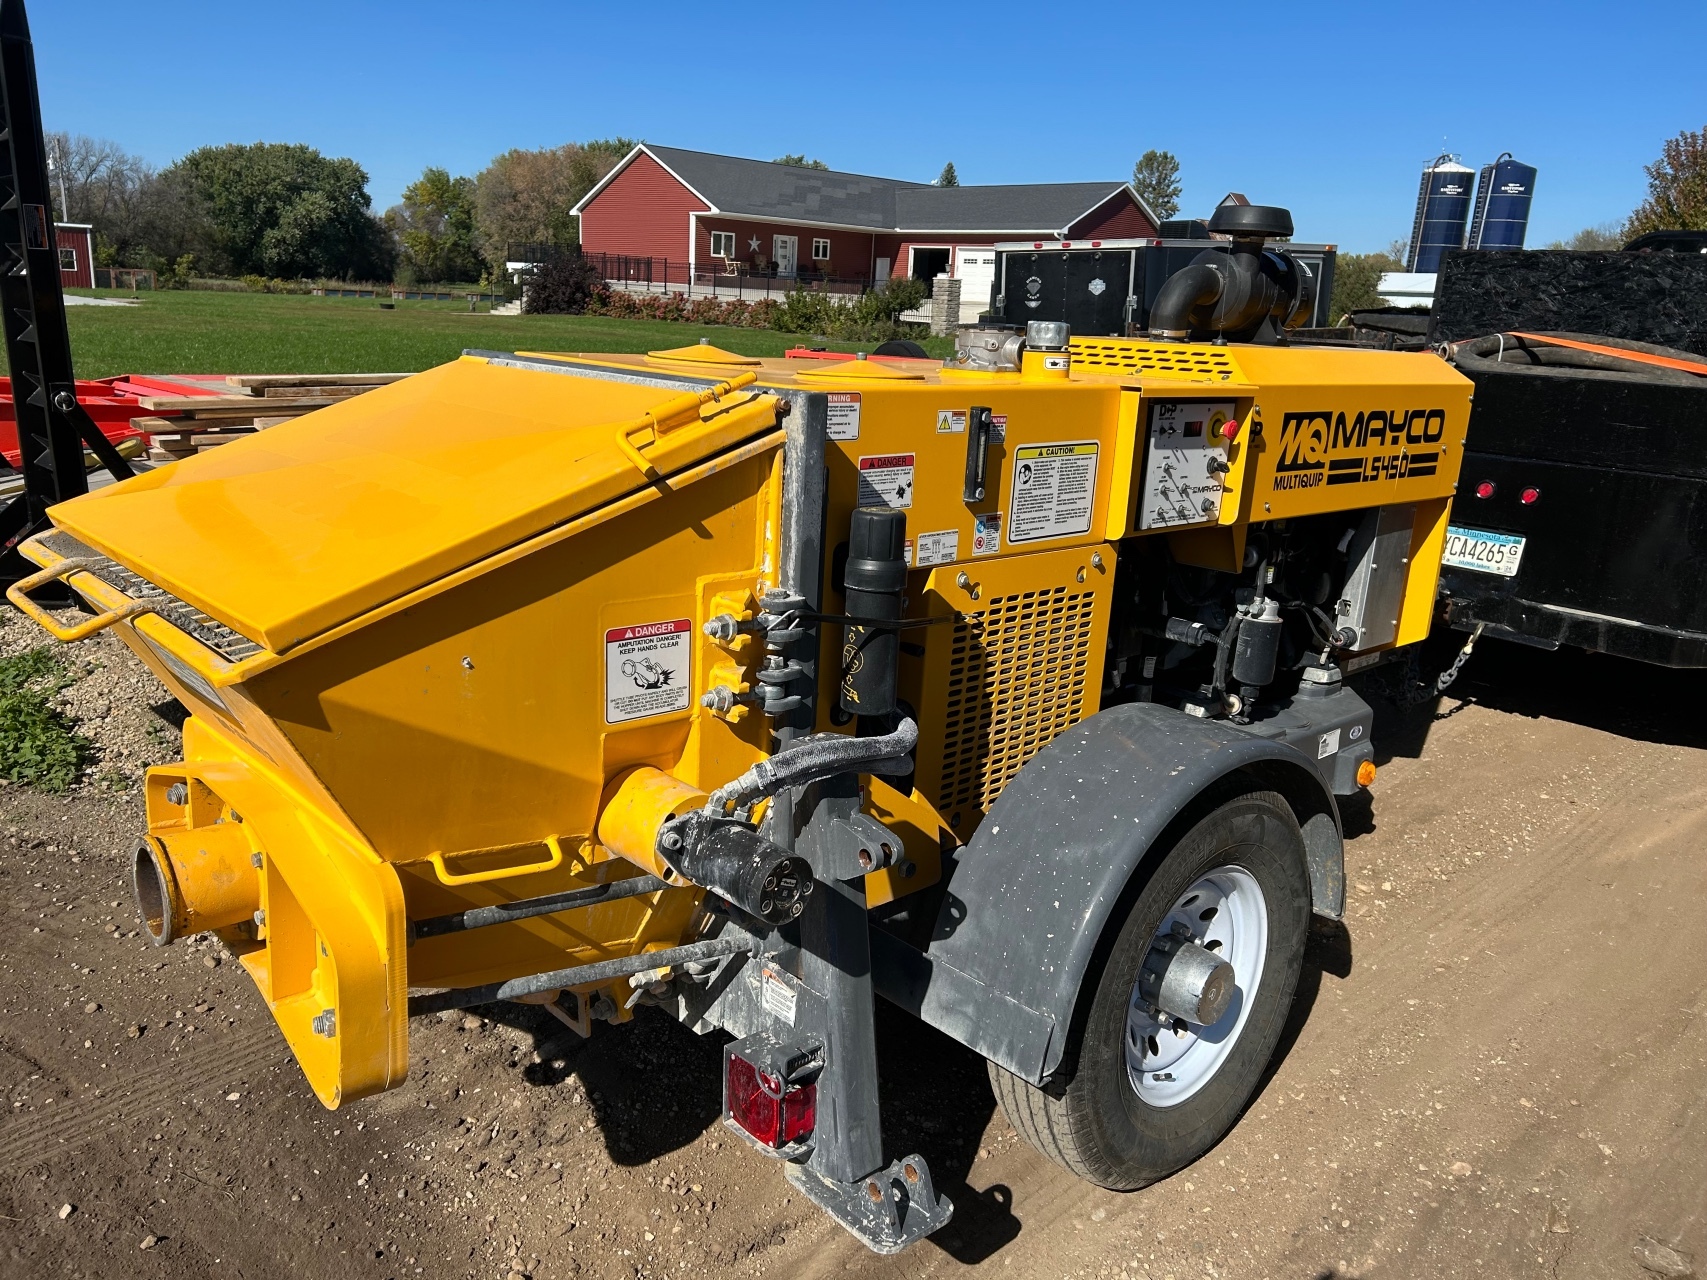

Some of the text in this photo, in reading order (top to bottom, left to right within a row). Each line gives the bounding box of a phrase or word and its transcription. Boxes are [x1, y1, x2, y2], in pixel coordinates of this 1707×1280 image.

[828, 394, 851, 402] RNING
[1332, 409, 1446, 449] MAYCO
[1046, 447, 1075, 456] CAUTION!
[877, 457, 907, 467] DANGER
[1362, 454, 1410, 482] LS450
[1273, 472, 1324, 491] MULTIQUIP
[1462, 528, 1501, 540] Minnesota
[1508, 545, 1519, 556] G
[635, 623, 675, 637] DANGER
[618, 634, 682, 649] AMPUTATION DANGER!
[637, 644, 658, 653] HANDS
[660, 641, 679, 649] CLEAR
